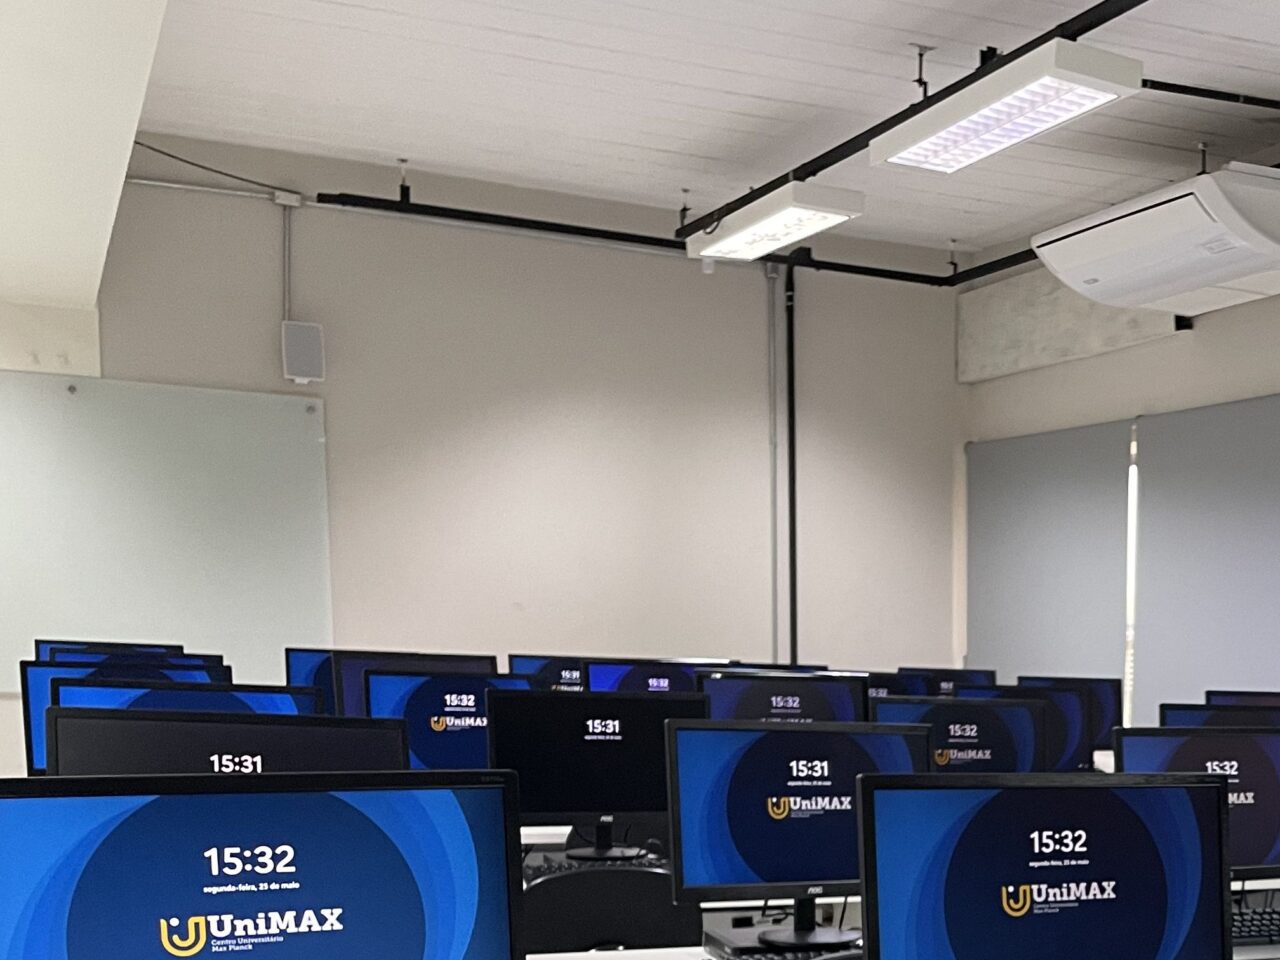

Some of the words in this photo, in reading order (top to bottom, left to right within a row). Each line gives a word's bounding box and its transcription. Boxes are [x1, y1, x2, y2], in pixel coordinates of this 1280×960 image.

[444, 694, 476, 706] 15:32
[771, 695, 800, 708] 15:32
[586, 719, 620, 733] 15:31
[948, 724, 978, 736] 15:32
[209, 754, 262, 774] 15:31
[788, 760, 829, 777] 15:31
[1206, 761, 1239, 775] 15:32
[790, 796, 852, 811] UniMAX
[1030, 830, 1087, 853] 15:32
[204, 845, 296, 876] 15:32
[1031, 881, 1116, 903] UniMAX
[207, 908, 343, 938] UniMAX
